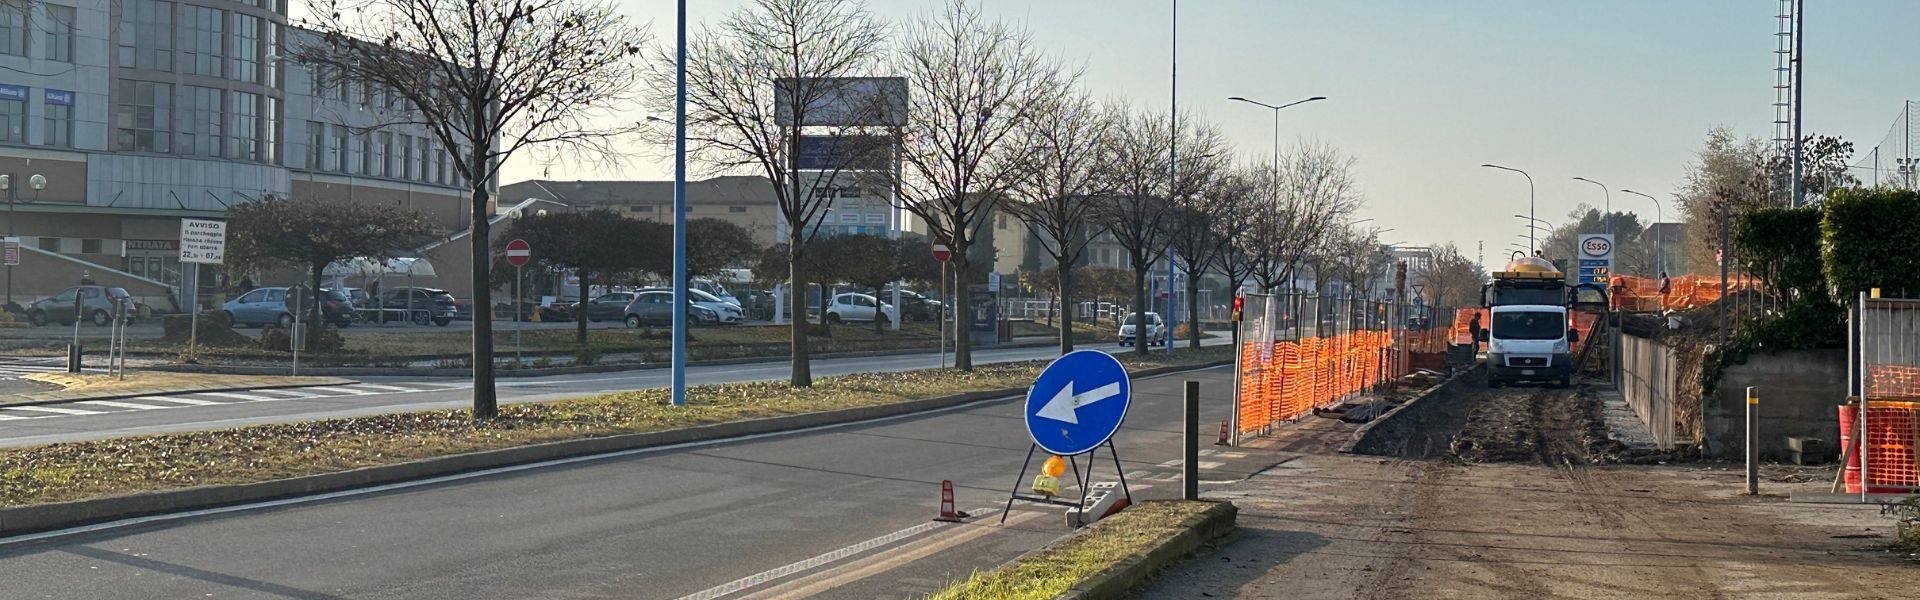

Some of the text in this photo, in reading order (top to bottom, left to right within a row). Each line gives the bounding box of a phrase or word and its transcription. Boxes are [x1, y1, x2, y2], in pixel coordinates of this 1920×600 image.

[190, 230, 222, 238] parcheggio
[128, 240, 172, 249] NTRATA
[1586, 241, 1608, 251] Esso
